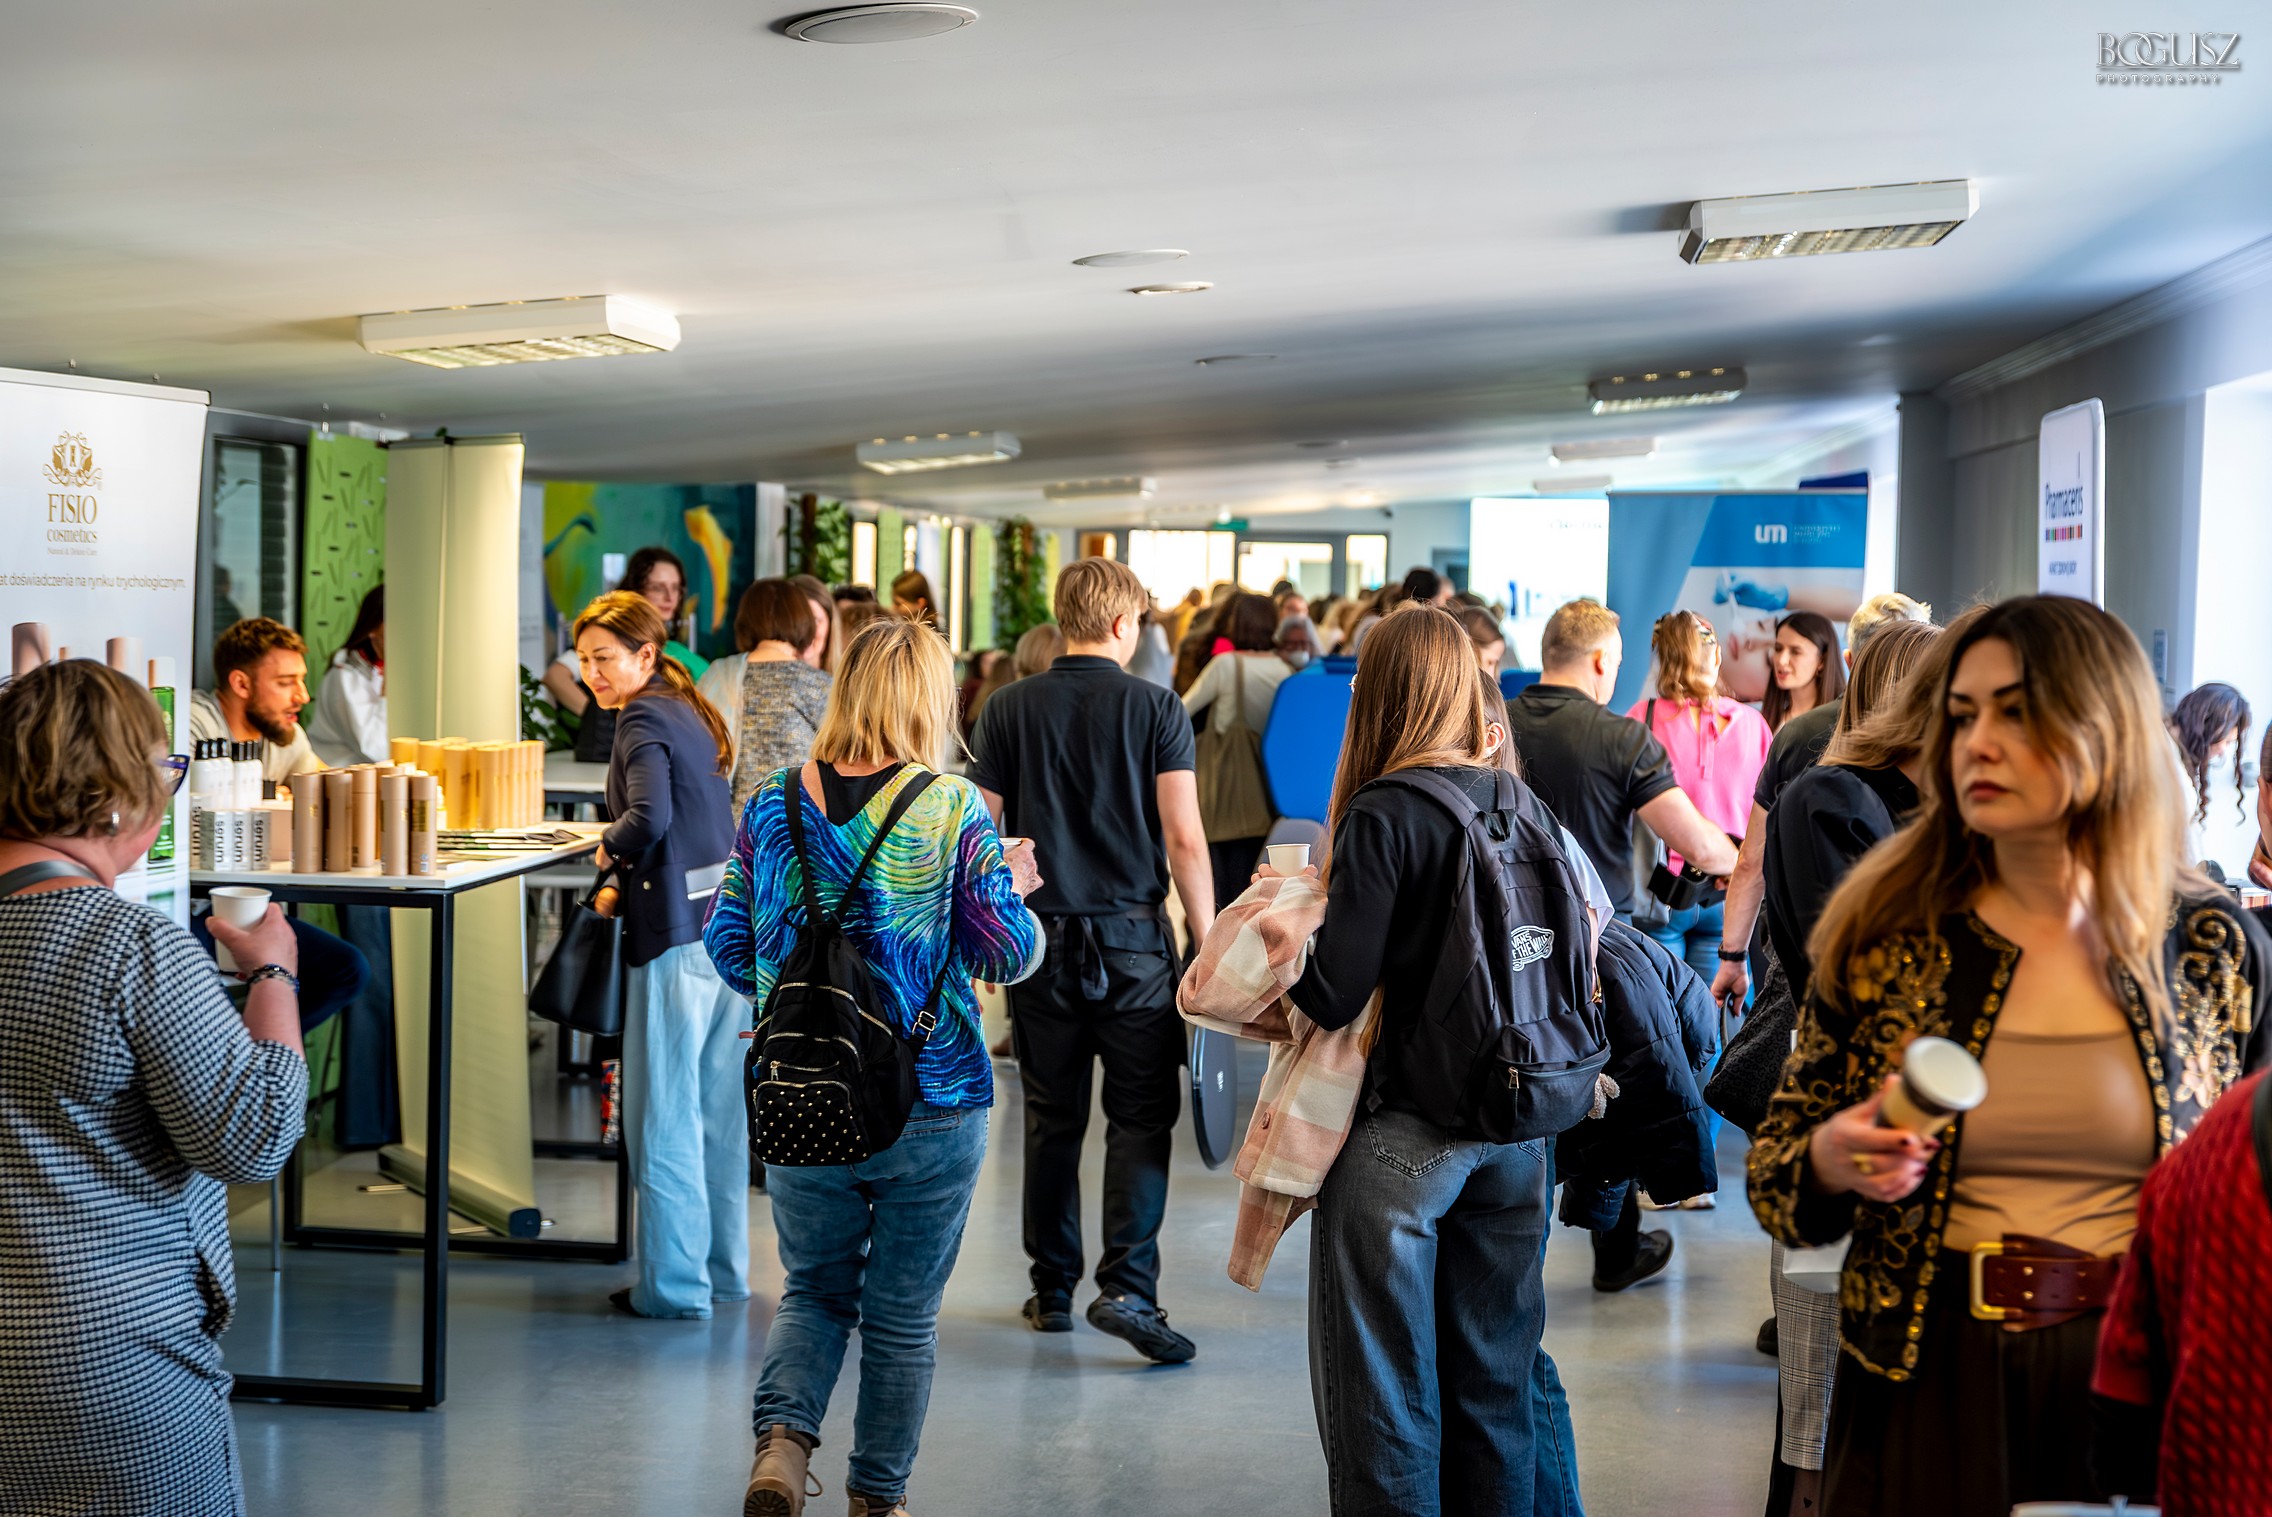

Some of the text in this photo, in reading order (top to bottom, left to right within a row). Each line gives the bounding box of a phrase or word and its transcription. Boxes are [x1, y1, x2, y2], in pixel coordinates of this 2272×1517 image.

[47, 493, 98, 525] FISIO
[47, 528, 98, 544] cosmetics
[9, 572, 74, 588] doświadczenia
[75, 577, 87, 587] na
[88, 574, 115, 591] rynku
[215, 821, 225, 863] serum
[234, 820, 244, 863] serum
[254, 819, 265, 862] serum
[1511, 930, 1532, 949] VANS
[1517, 942, 1534, 958] THE
[1530, 934, 1547, 953] WALL
